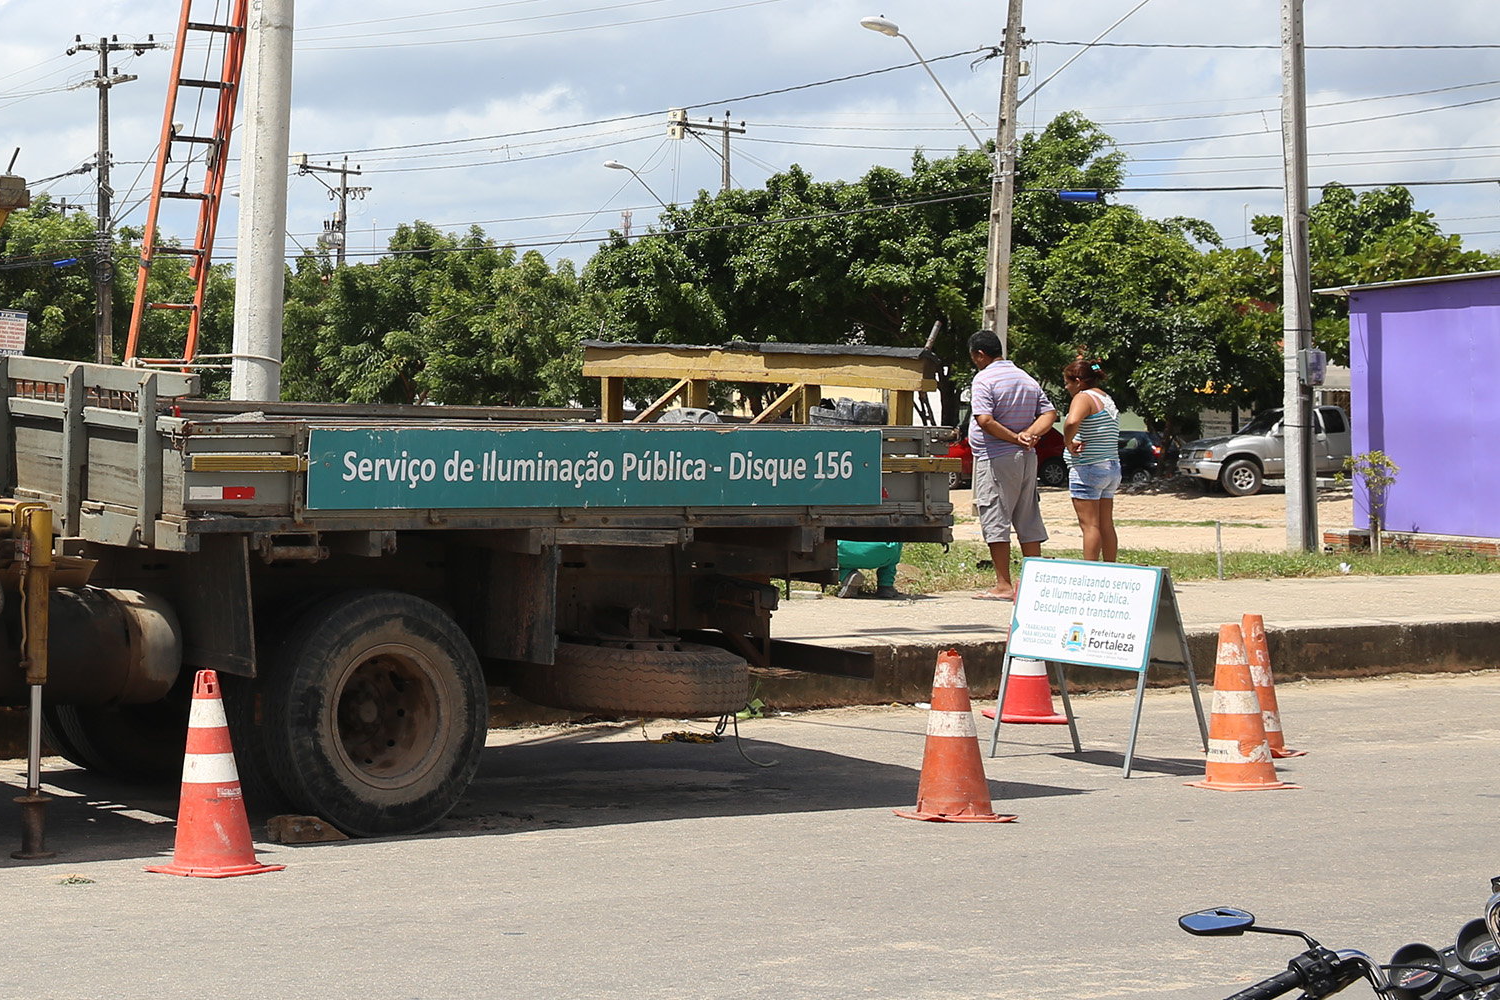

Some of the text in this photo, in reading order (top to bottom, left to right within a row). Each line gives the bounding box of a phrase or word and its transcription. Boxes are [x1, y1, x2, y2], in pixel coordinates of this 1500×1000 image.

[342, 450, 437, 489] Serviço
[443, 450, 474, 482] de
[482, 450, 615, 489] Iluminação
[622, 450, 707, 482] Pública
[729, 450, 807, 487] Disque
[814, 451, 854, 480] 156
[1034, 571, 1142, 593] Estamos realizando serviço
[1040, 586, 1130, 606] de Iluminação Pública.
[1033, 600, 1132, 621] Desculpem o transtorno.
[1088, 637, 1135, 653] Fortaleza
[1090, 629, 1136, 641] Prefeitura de
